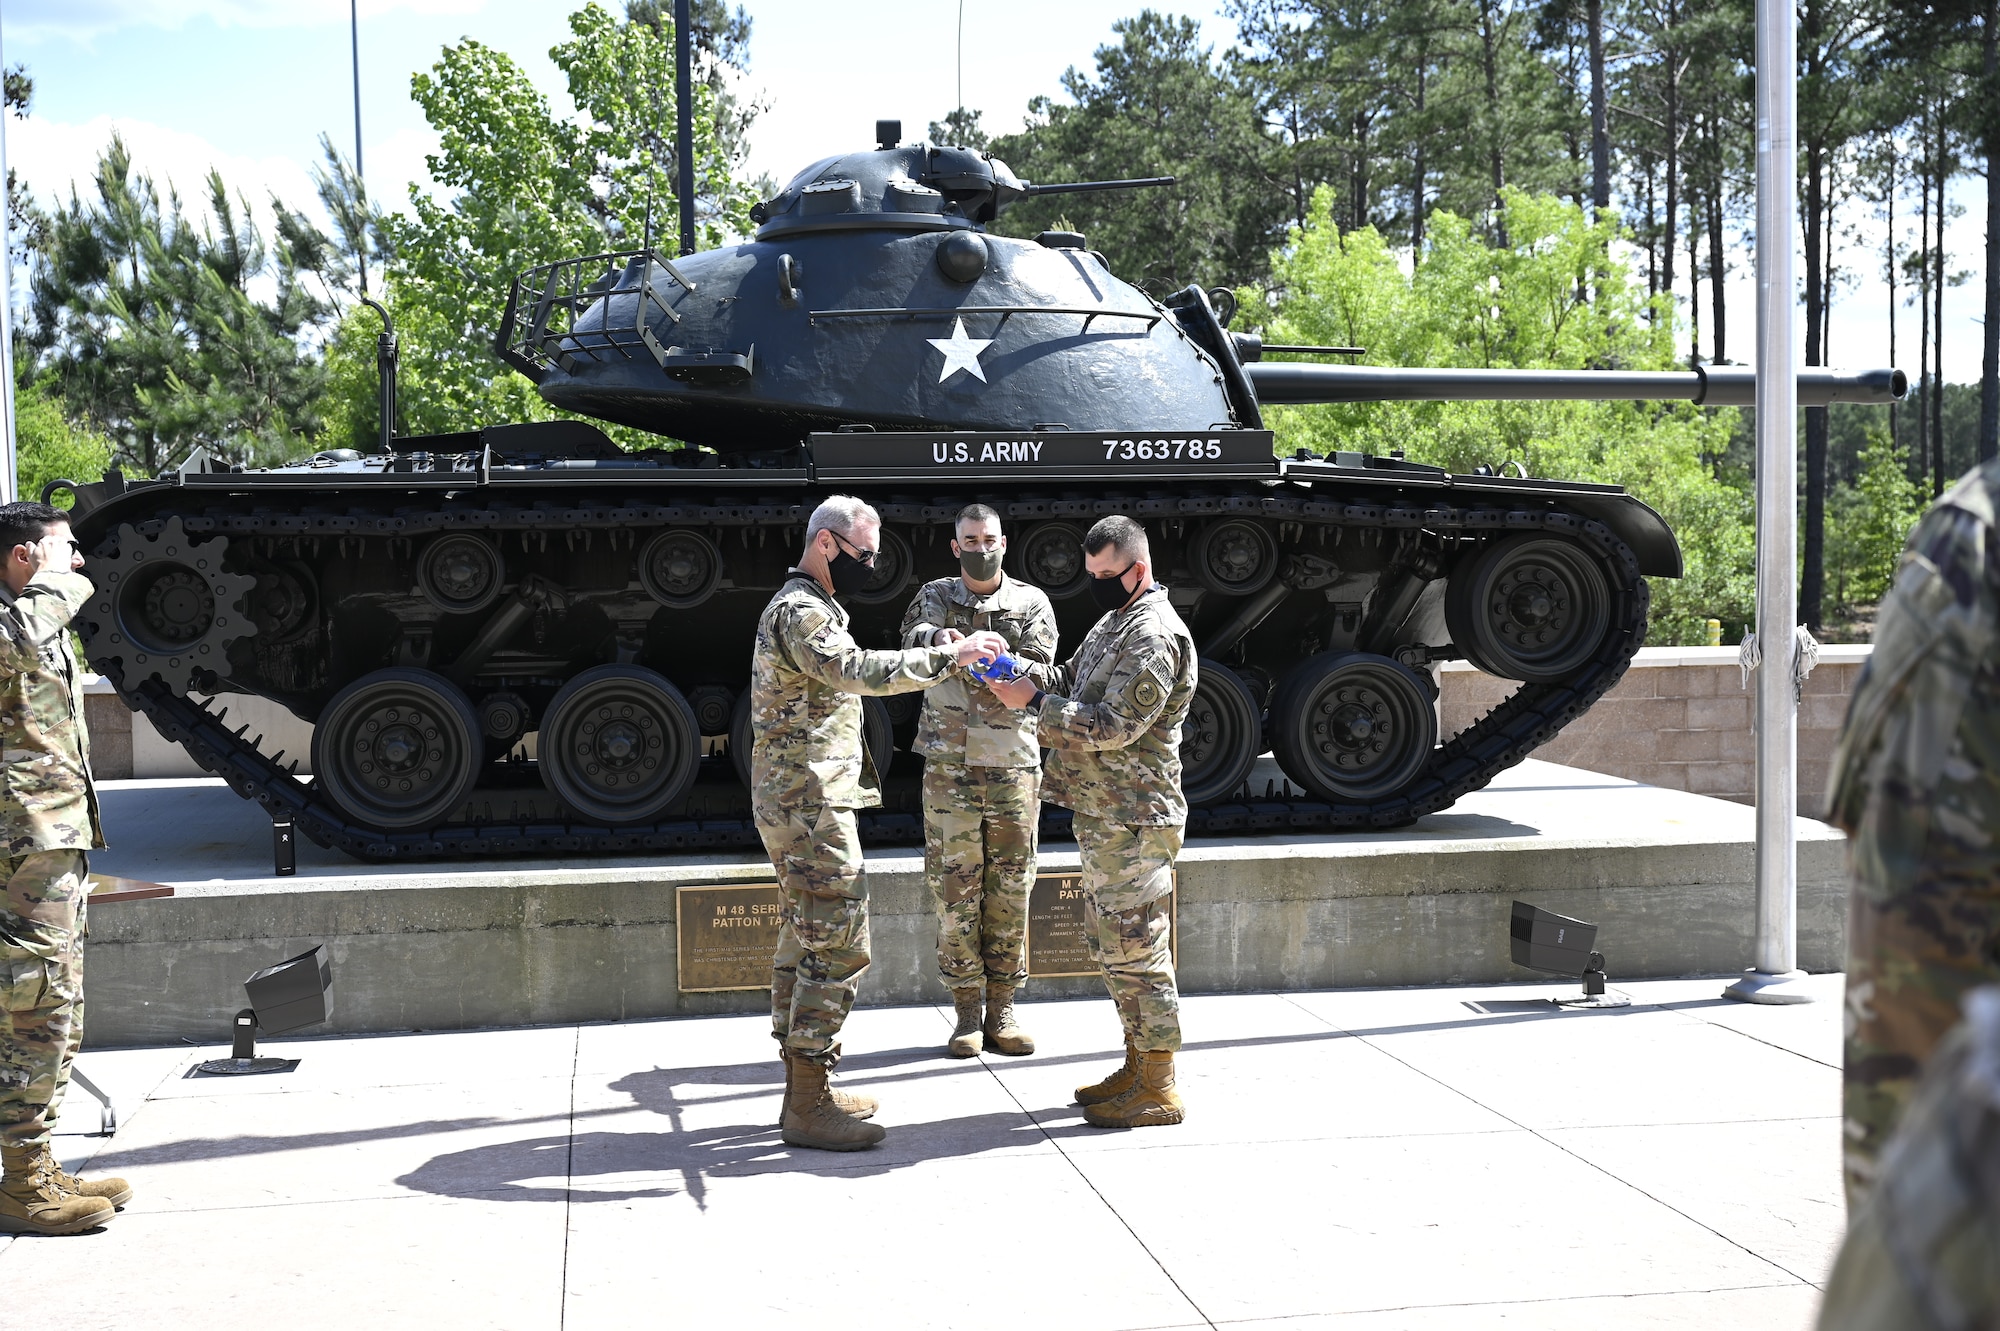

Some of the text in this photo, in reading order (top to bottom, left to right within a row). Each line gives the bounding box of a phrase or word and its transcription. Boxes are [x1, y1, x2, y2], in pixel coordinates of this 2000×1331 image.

[932, 441, 1043, 463] U.S. ARMY
[1102, 439, 1222, 460] 7363785
[1061, 880, 1083, 889] M 4
[1059, 890, 1086, 900] PATT
[716, 904, 780, 916] M 48 SERI
[712, 916, 782, 928] PATTON TA
